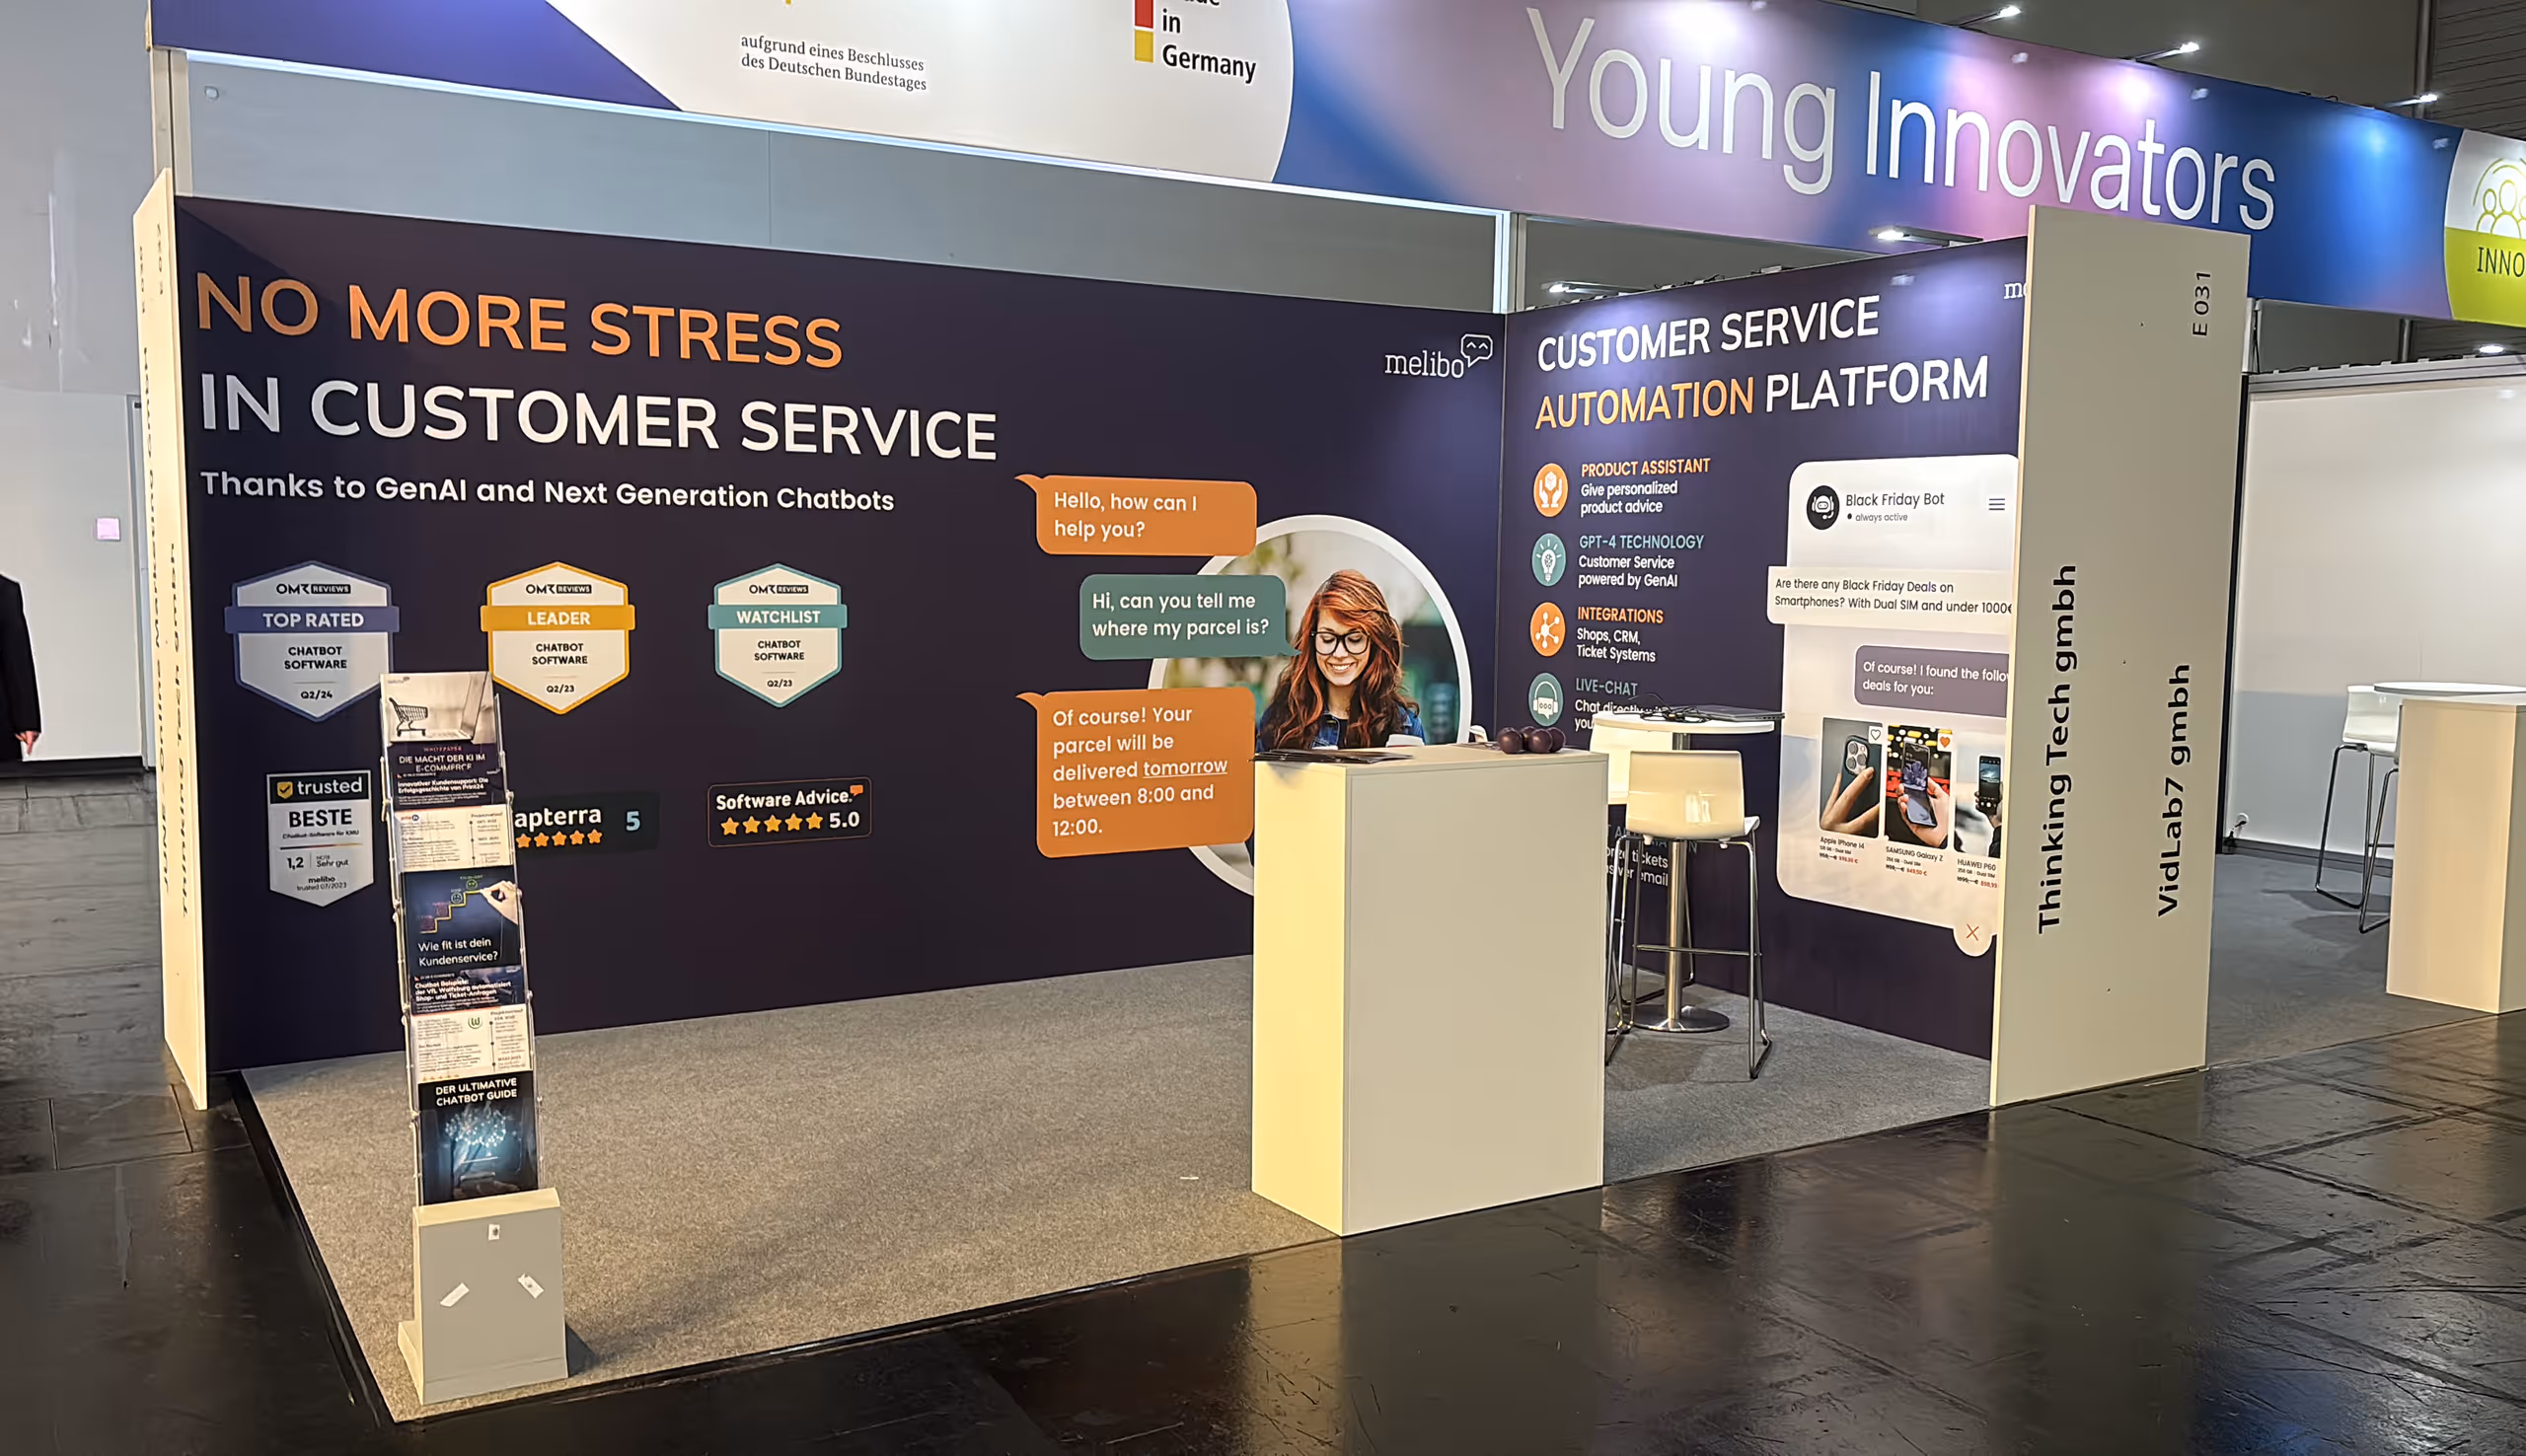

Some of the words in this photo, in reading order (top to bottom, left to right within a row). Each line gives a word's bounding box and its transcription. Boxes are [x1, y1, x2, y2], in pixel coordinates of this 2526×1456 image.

[1162, 8, 1180, 34] in
[741, 36, 805, 54] aufgrund
[809, 43, 844, 60] eines
[848, 48, 924, 71] Beschlusses
[741, 53, 765, 69] des
[769, 57, 841, 79] Deutschen
[845, 67, 927, 92] Bundestages
[1162, 44, 1256, 84] Germany
[1525, 5, 1835, 194] Young
[1864, 69, 2276, 231] Innovators
[2477, 247, 2525, 277] INNO
[2194, 273, 2210, 315] 031
[197, 272, 320, 338] NO
[348, 284, 567, 352] MORE
[590, 301, 844, 369] STRESS
[2192, 324, 2207, 335] E
[1537, 317, 1711, 372] CUSTOMER
[1721, 295, 1881, 351] SERVICE
[1384, 349, 1464, 378] melibo
[1535, 376, 1754, 430] AUTOMATION
[1765, 354, 1989, 412] PLATFORM
[201, 373, 281, 433] IN
[310, 379, 720, 451] CUSTOMER
[740, 400, 999, 462] SERVICE
[1582, 461, 1638, 477] PRODUCT
[1641, 458, 1711, 474] ASSISTANT
[200, 471, 324, 499] Thanks
[334, 474, 366, 500] to
[375, 475, 469, 503] GenAI
[476, 478, 536, 505] and
[545, 477, 608, 506] Next
[616, 482, 769, 510] Generation
[777, 486, 896, 512] Chatbots
[1581, 483, 1604, 496] Give
[1607, 480, 1677, 499] personalized
[1054, 492, 1105, 512] Hello,
[1110, 493, 1148, 510] how
[1153, 496, 1186, 511] can
[1192, 496, 1197, 511] I
[1581, 500, 1622, 518] product
[1625, 499, 1663, 512] advice
[1846, 494, 1878, 506] Black
[1882, 493, 1920, 509] Friday
[1924, 493, 1945, 505] Bot
[1855, 513, 1882, 523] always
[1055, 520, 1095, 542] help
[1101, 522, 1146, 542] you?
[1580, 535, 1616, 548] GPT-4
[1620, 535, 1704, 548] TECHNOLOGY
[1579, 555, 1631, 569] Customer
[1634, 555, 1674, 569] Service
[312, 584, 350, 594] REVIEWS
[1578, 573, 1624, 588] powered
[1627, 573, 1641, 590] by
[1644, 574, 1677, 587] GenAI
[1775, 579, 1791, 589] Are
[1794, 579, 1820, 590] there
[1821, 581, 1840, 593] any
[1842, 580, 1870, 591] Black
[1873, 581, 1904, 594] Friday
[1906, 582, 1936, 593] Deals
[1940, 584, 1954, 593] on
[1092, 593, 1114, 612] Hi,
[1120, 595, 1153, 609] can
[1158, 595, 1191, 613] you
[1197, 592, 1224, 609] tell
[1228, 595, 1256, 608] me
[1775, 596, 1845, 610] Smartphones?
[1848, 598, 1871, 609] With
[1874, 599, 1896, 610] Dual
[1900, 600, 1918, 611] SIM
[1921, 601, 1943, 612] and
[1946, 601, 1978, 613] under
[1981, 603, 2013, 615] 1000€
[262, 613, 301, 627] TOP
[306, 613, 364, 627] RATED
[527, 612, 590, 625] LEADER
[737, 611, 821, 623] WATCHLIST
[1578, 607, 1665, 623] INTEGRATIONS
[2051, 564, 2078, 673] gmbh
[1092, 620, 1148, 636] where
[1153, 621, 1182, 640] my
[1187, 619, 1241, 639] parcel
[1245, 619, 1269, 634] is?
[1577, 628, 1611, 643] Shops,
[1613, 630, 1641, 645] CRM,
[288, 646, 342, 656] CHATBOT
[536, 643, 584, 652] CHATBOT
[754, 652, 804, 661] SOFTWARE
[1577, 644, 1607, 659] Ticket
[1609, 647, 1656, 663] Systems
[284, 659, 347, 670] SOFTWARE
[532, 656, 588, 665] SOFTWARE
[1863, 661, 1875, 673] Of
[1878, 663, 1917, 675] course!
[1926, 665, 1958, 678] found
[1962, 668, 1979, 680] the
[1982, 669, 2009, 682] follo
[301, 691, 333, 699] Q2/24
[547, 684, 574, 693] Q2/23
[1576, 678, 1638, 695] LIVE-CHAT
[1863, 680, 1891, 691] deals
[1894, 681, 1907, 692] for
[1911, 685, 1934, 696] you:
[1575, 699, 1600, 712] Chat
[2167, 664, 2191, 766] gmbh
[1053, 709, 1074, 726] Of
[1078, 706, 1146, 725] course!
[1152, 707, 1192, 722] Your
[2045, 684, 2071, 767] Tech
[1053, 736, 1111, 759] parcel
[1117, 734, 1147, 751] will
[1152, 734, 1174, 750] be
[1053, 762, 1138, 781] delivered
[1144, 759, 1227, 776] tomorrow
[297, 776, 362, 795] trusted
[716, 794, 791, 810] Software
[1053, 791, 1132, 809] between
[1137, 787, 1174, 804] 8:00
[1180, 784, 1214, 801] and
[289, 808, 352, 828] BESTE
[514, 807, 602, 832] apterra
[626, 810, 640, 832] 5
[830, 812, 859, 829] 5.0
[1053, 819, 1102, 837] 12:00.
[1886, 846, 1915, 857] SAMSUNG
[1916, 850, 1938, 862] Galaxy
[2039, 772, 2072, 935] Thinking
[2157, 776, 2185, 918] VidLab7
[286, 856, 304, 870] 1,2
[316, 859, 334, 868] Sehr
[335, 858, 348, 868] gut
[1958, 858, 1982, 869] HUAWEI
[418, 942, 439, 952] Wie
[442, 940, 452, 950] fit
[455, 939, 467, 949] ist
[470, 938, 491, 948] dein
[418, 951, 497, 967] Kundenservice?
[436, 1086, 456, 1095] DER
[458, 1078, 517, 1092] ULTIMATIVE
[436, 1093, 484, 1106] CHATBOT
[486, 1089, 517, 1099] GUIDE
